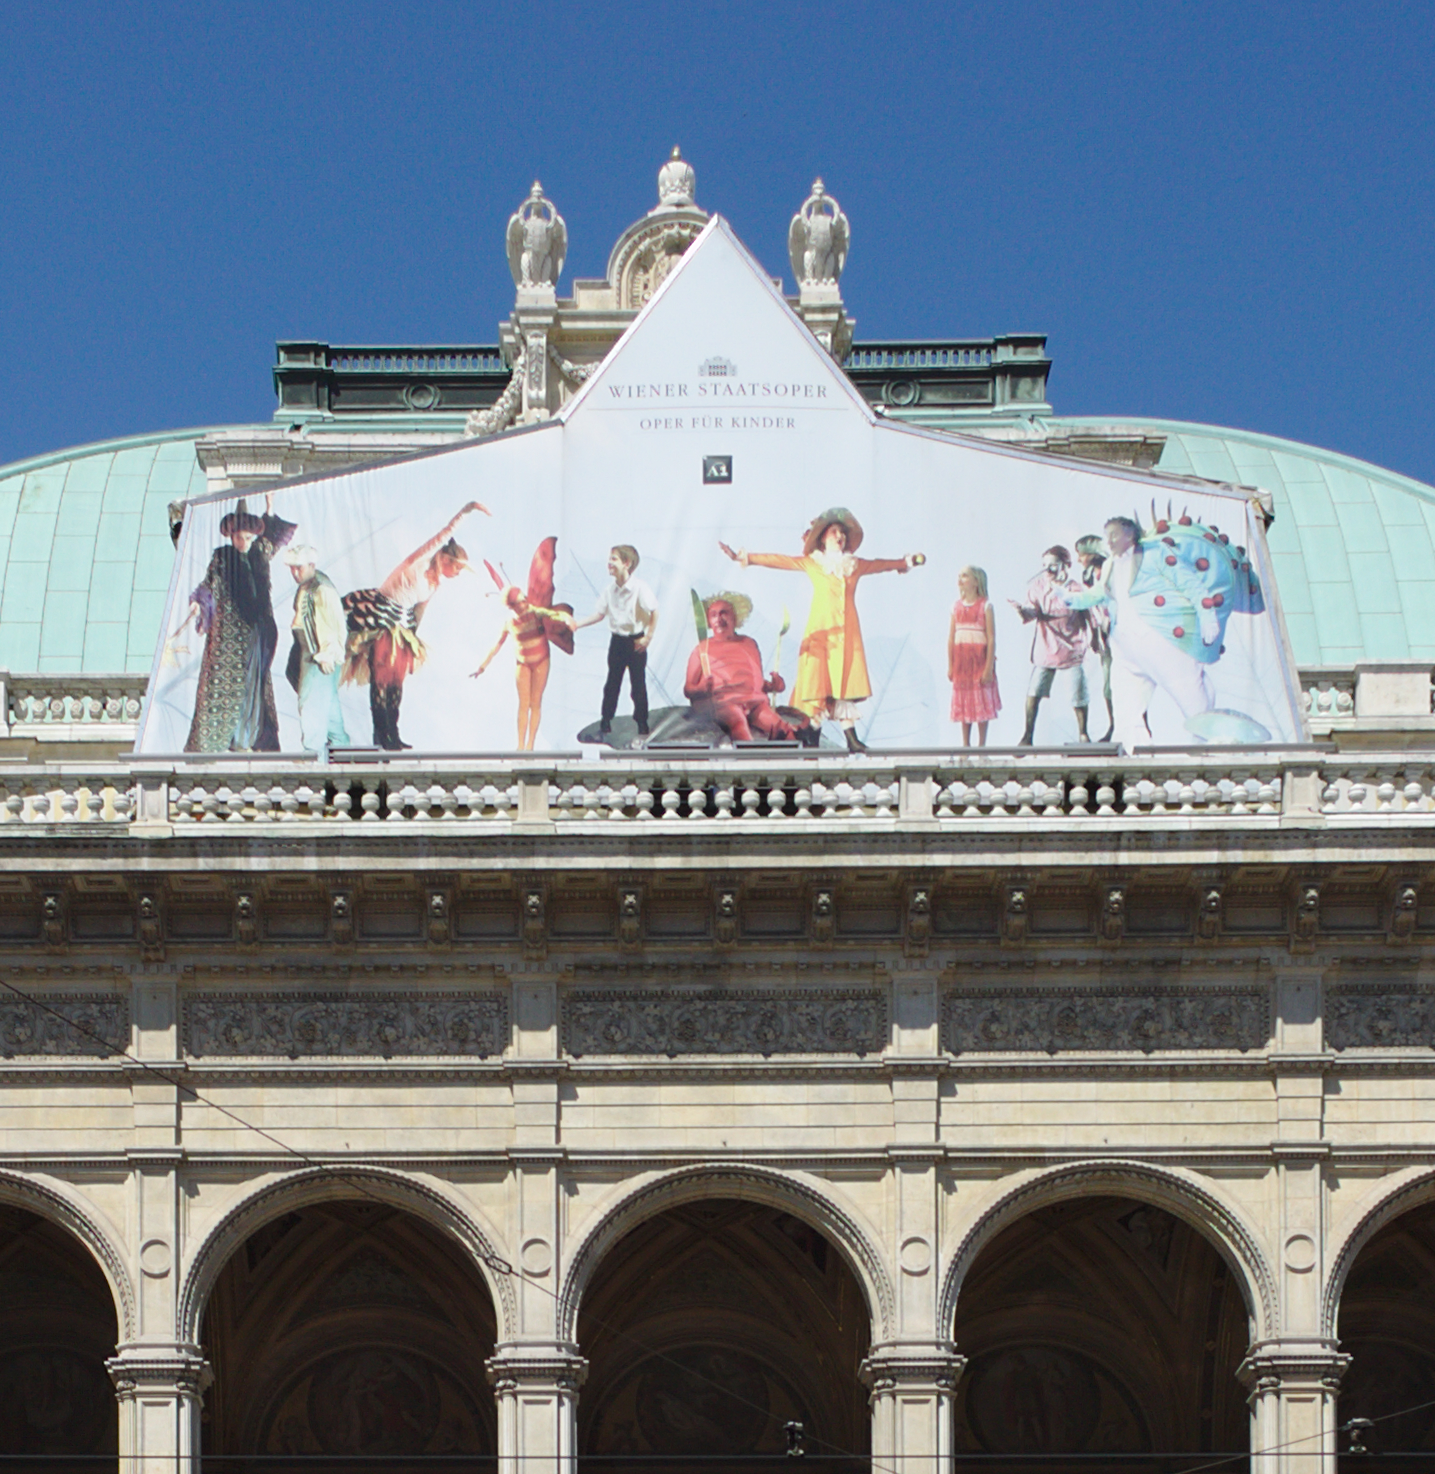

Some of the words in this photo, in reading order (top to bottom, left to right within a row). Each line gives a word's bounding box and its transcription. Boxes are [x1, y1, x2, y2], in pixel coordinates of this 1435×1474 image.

[609, 383, 689, 399] WIENER
[698, 382, 829, 399] STAATSOPER
[639, 417, 684, 431] OPER
[691, 414, 724, 430] FÜR
[731, 416, 796, 430] KINDER
